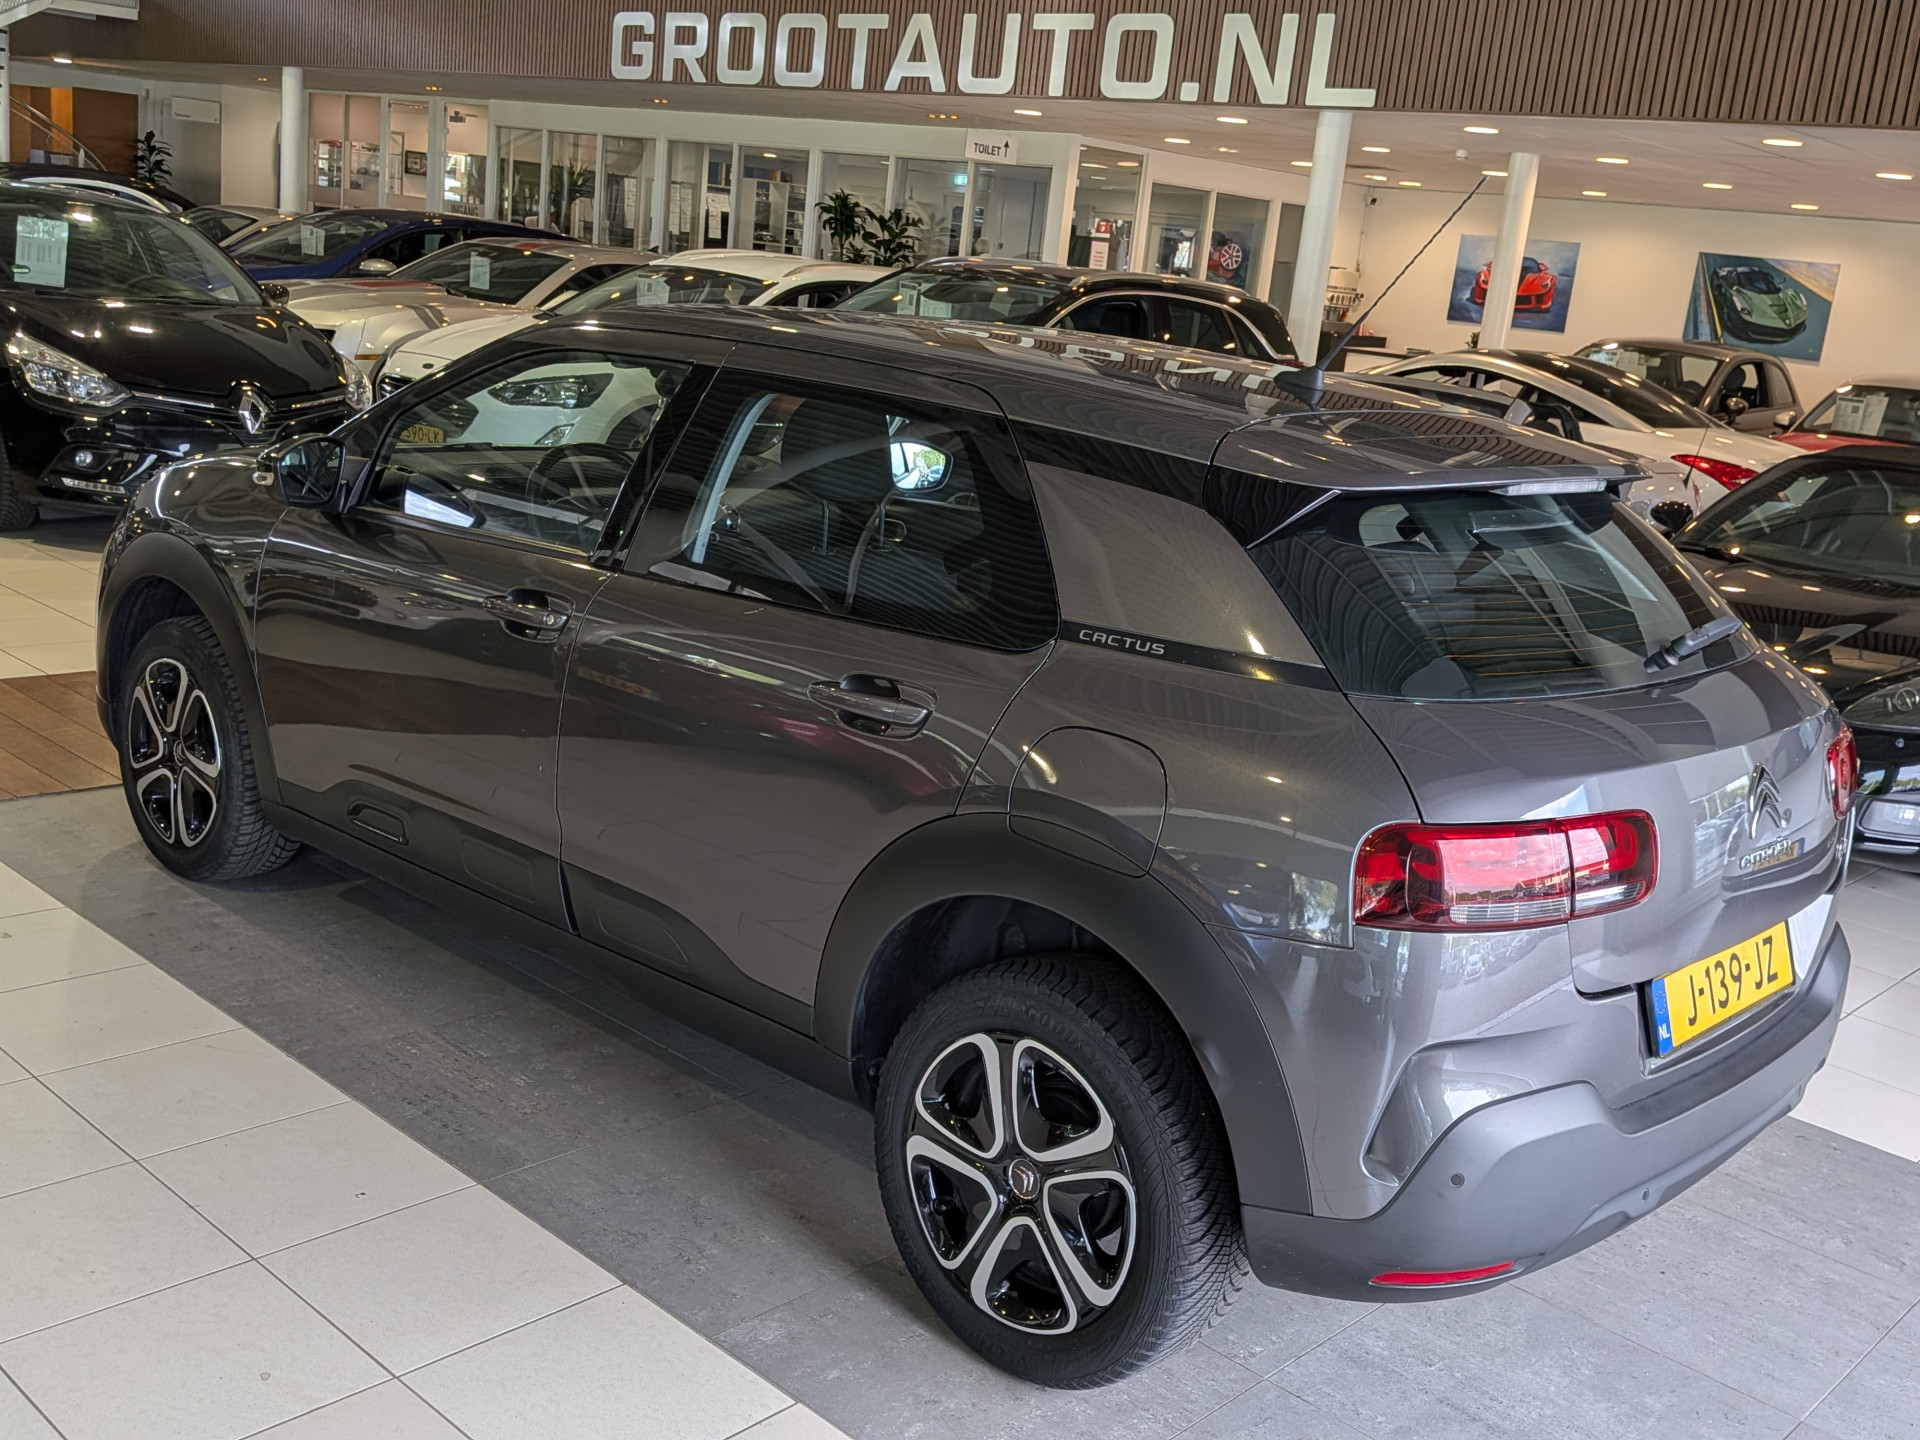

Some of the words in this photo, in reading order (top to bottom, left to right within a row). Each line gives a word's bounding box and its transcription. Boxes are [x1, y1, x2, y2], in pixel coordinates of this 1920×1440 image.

[611, 11, 1377, 107] GROOTAUTO.NL
[974, 142, 1002, 157] TOILET
[1079, 629, 1165, 655] CACTUS
[1687, 935, 1779, 1027] J-139-JZ
[1658, 1023, 1671, 1041] NL
